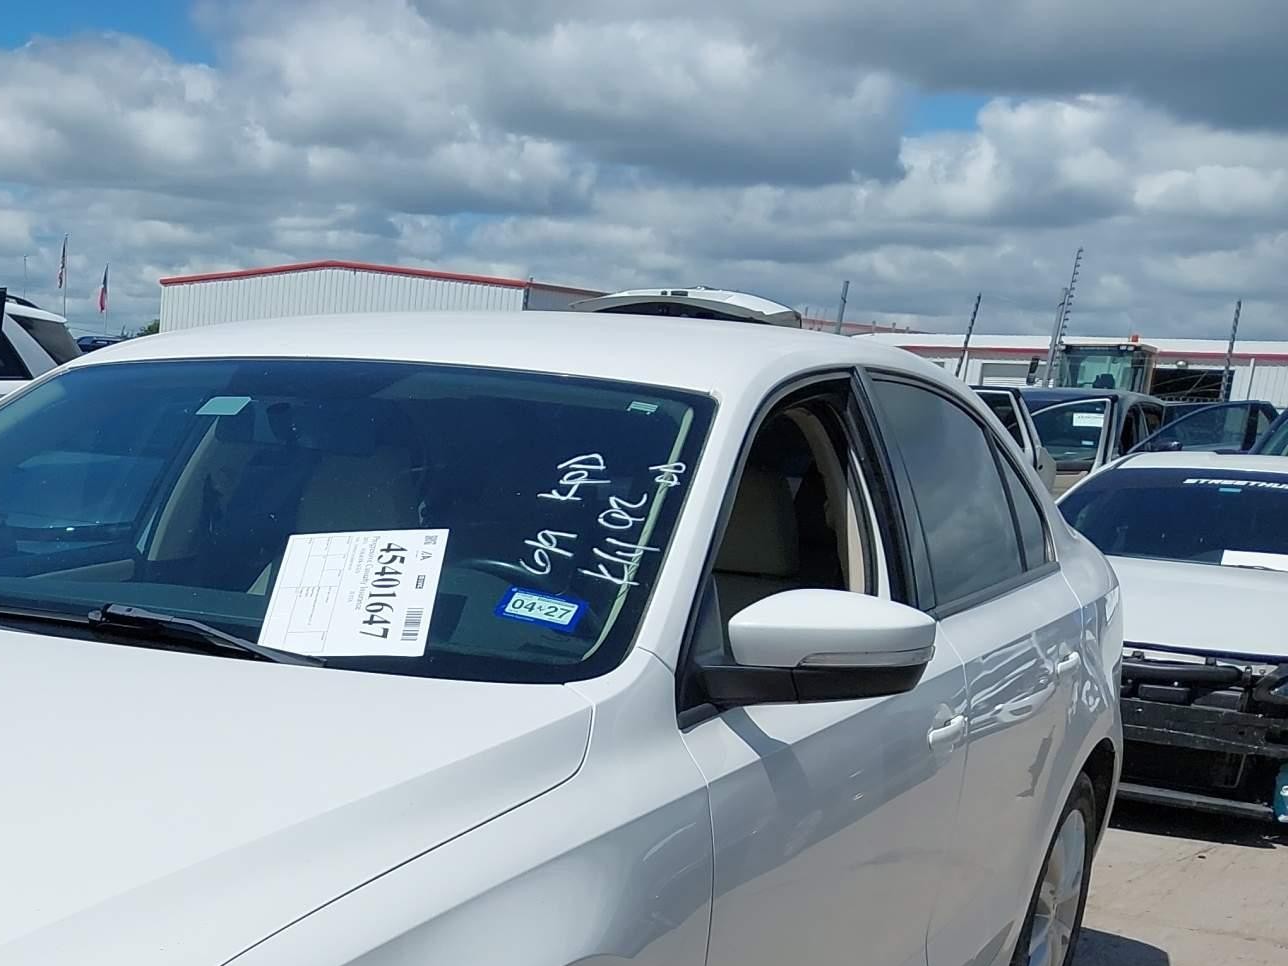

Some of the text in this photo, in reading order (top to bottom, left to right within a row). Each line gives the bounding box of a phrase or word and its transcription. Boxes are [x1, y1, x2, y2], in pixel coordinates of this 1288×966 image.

[359, 542, 408, 639] 45401647
[511, 599, 572, 619] 04 27
